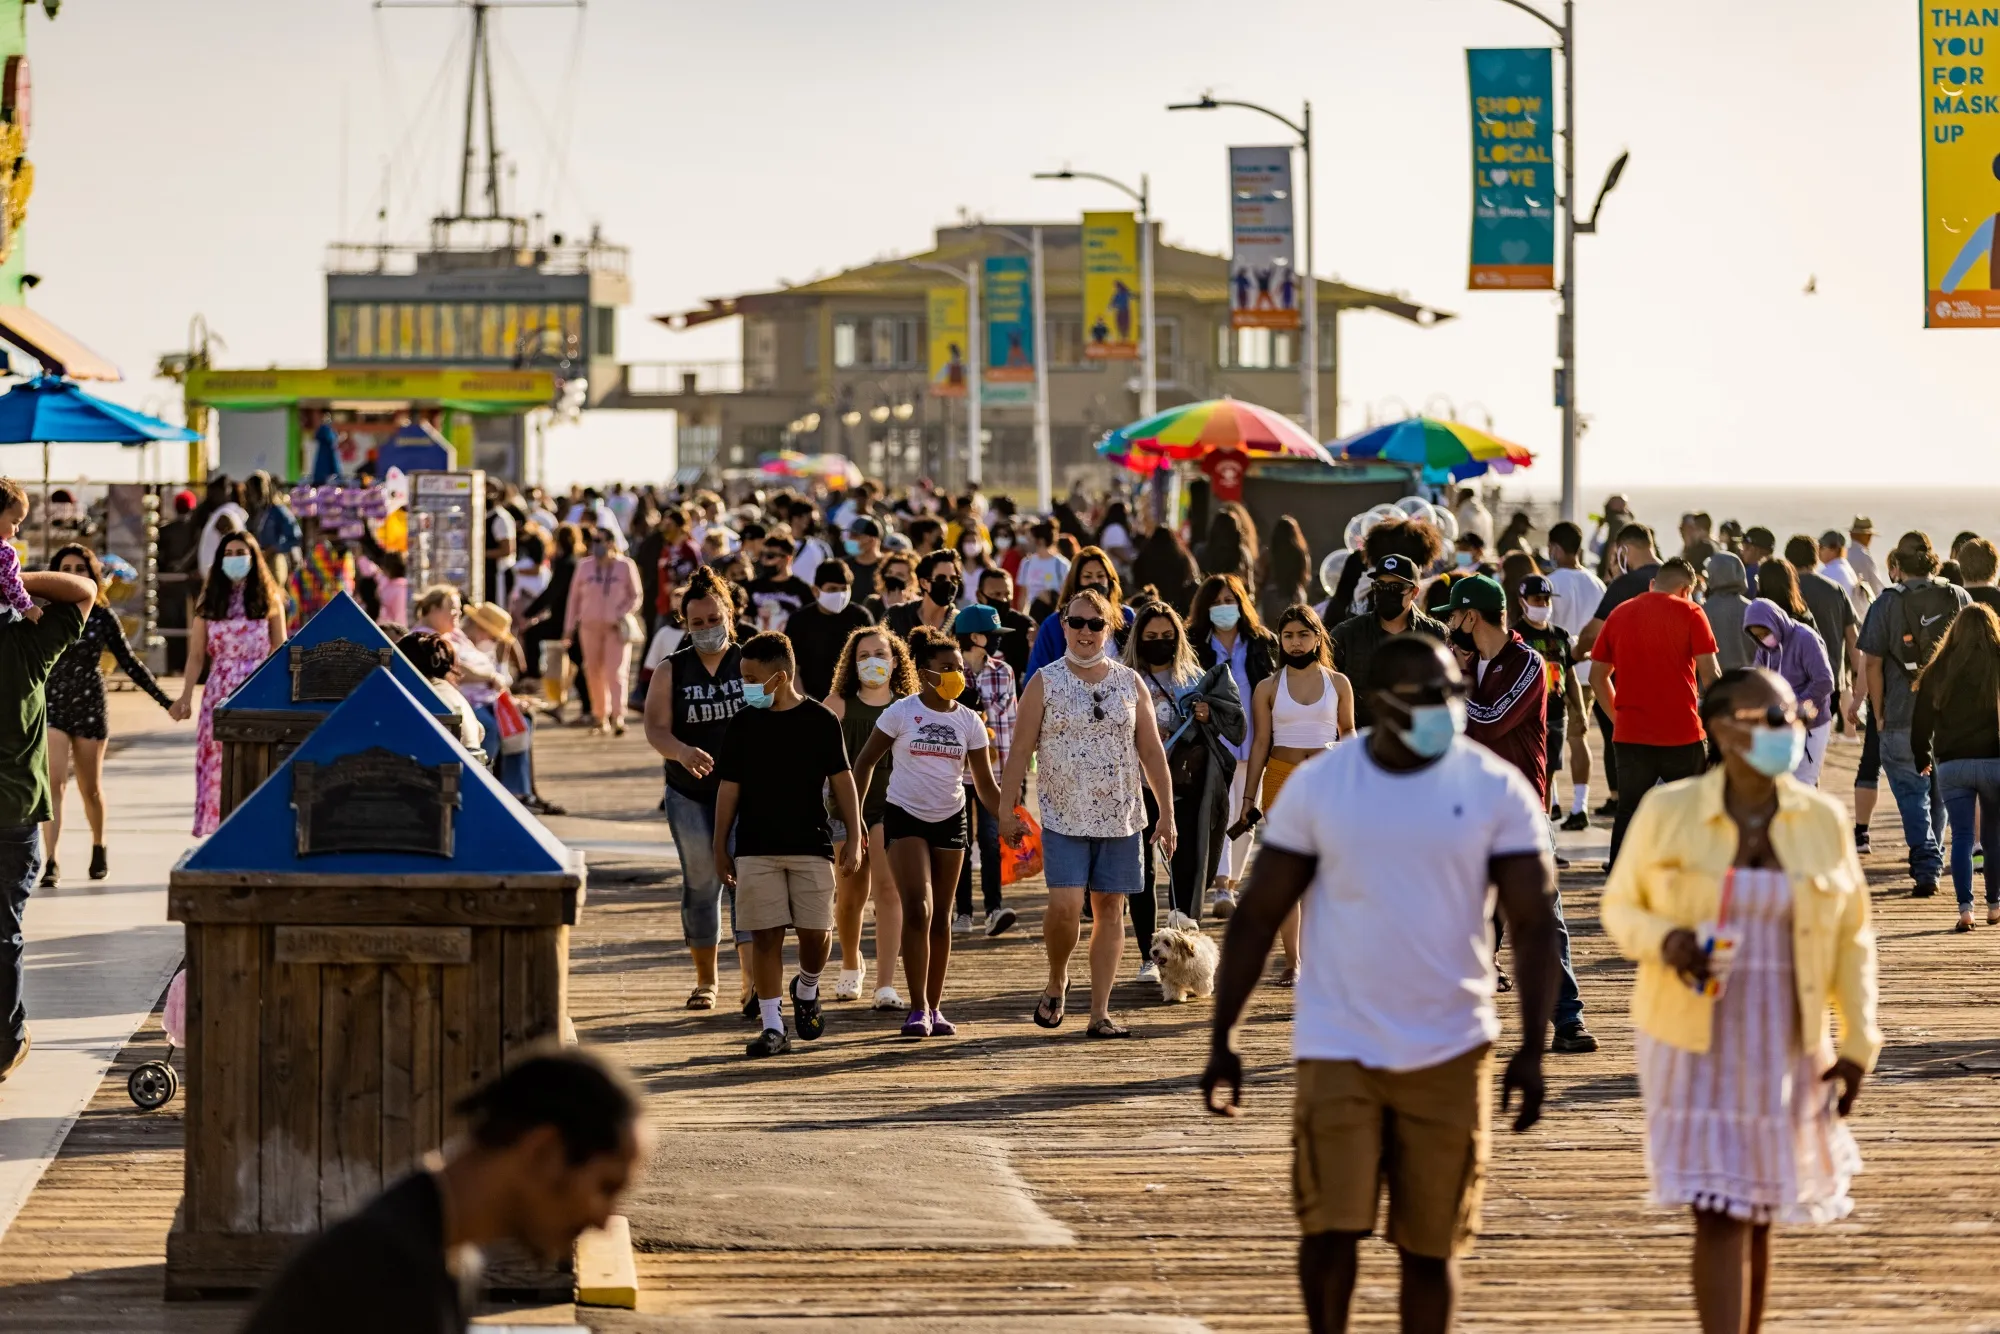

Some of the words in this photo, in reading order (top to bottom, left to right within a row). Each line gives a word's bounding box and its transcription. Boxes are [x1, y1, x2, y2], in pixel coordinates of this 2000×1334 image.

[1932, 37, 1984, 56] YOU
[1933, 66, 1984, 85] FOR
[1476, 96, 1541, 115] SHOW
[1933, 95, 1999, 114] MASK
[1478, 121, 1536, 139] YOUR
[1934, 124, 1965, 144] UP
[1478, 144, 1552, 163] LOCAL
[686, 696, 746, 723] ADDIC
[909, 741, 947, 754] CALIFORNIA
